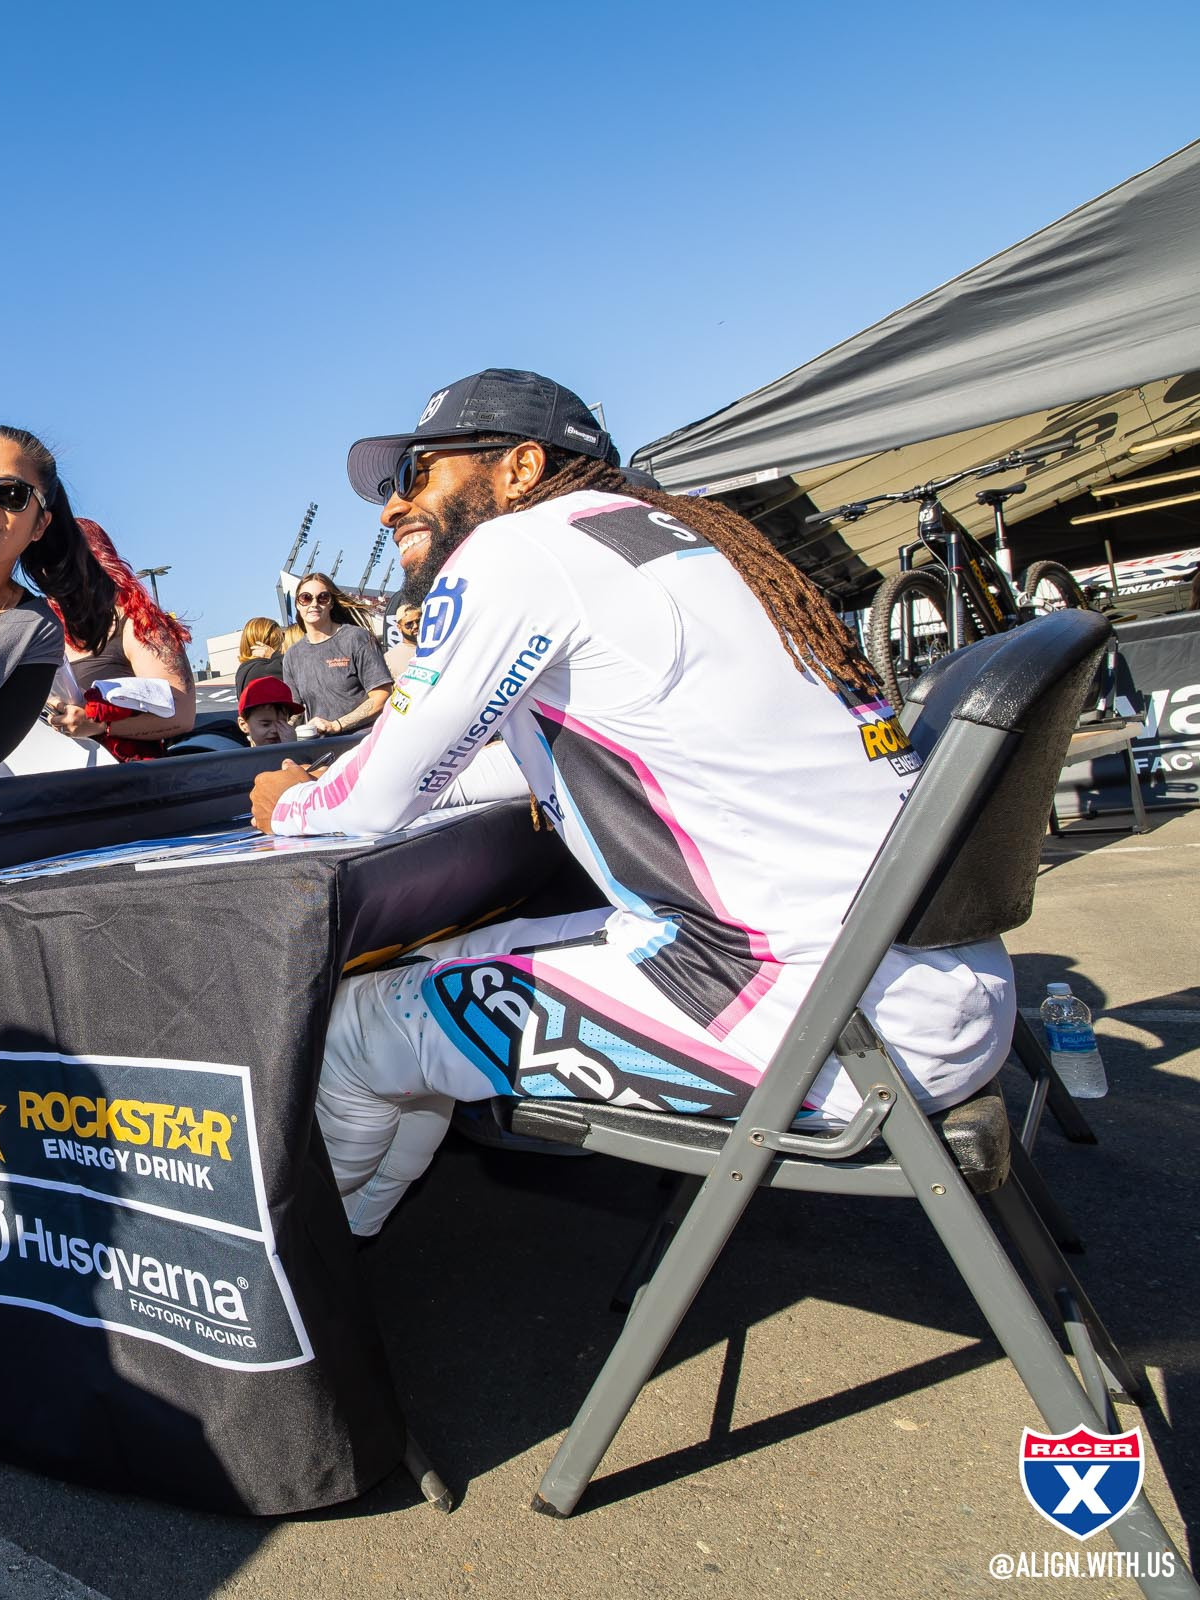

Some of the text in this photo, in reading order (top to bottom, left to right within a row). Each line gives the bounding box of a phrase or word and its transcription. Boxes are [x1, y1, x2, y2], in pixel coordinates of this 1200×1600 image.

[440, 633, 554, 770] Husqvarna
[18, 1090, 233, 1161] ROCKSTAR
[44, 1138, 214, 1191] ENERGY DRINK
[16, 1213, 249, 1322] Husqvarna
[130, 1299, 257, 1349] FACTORY RACING
